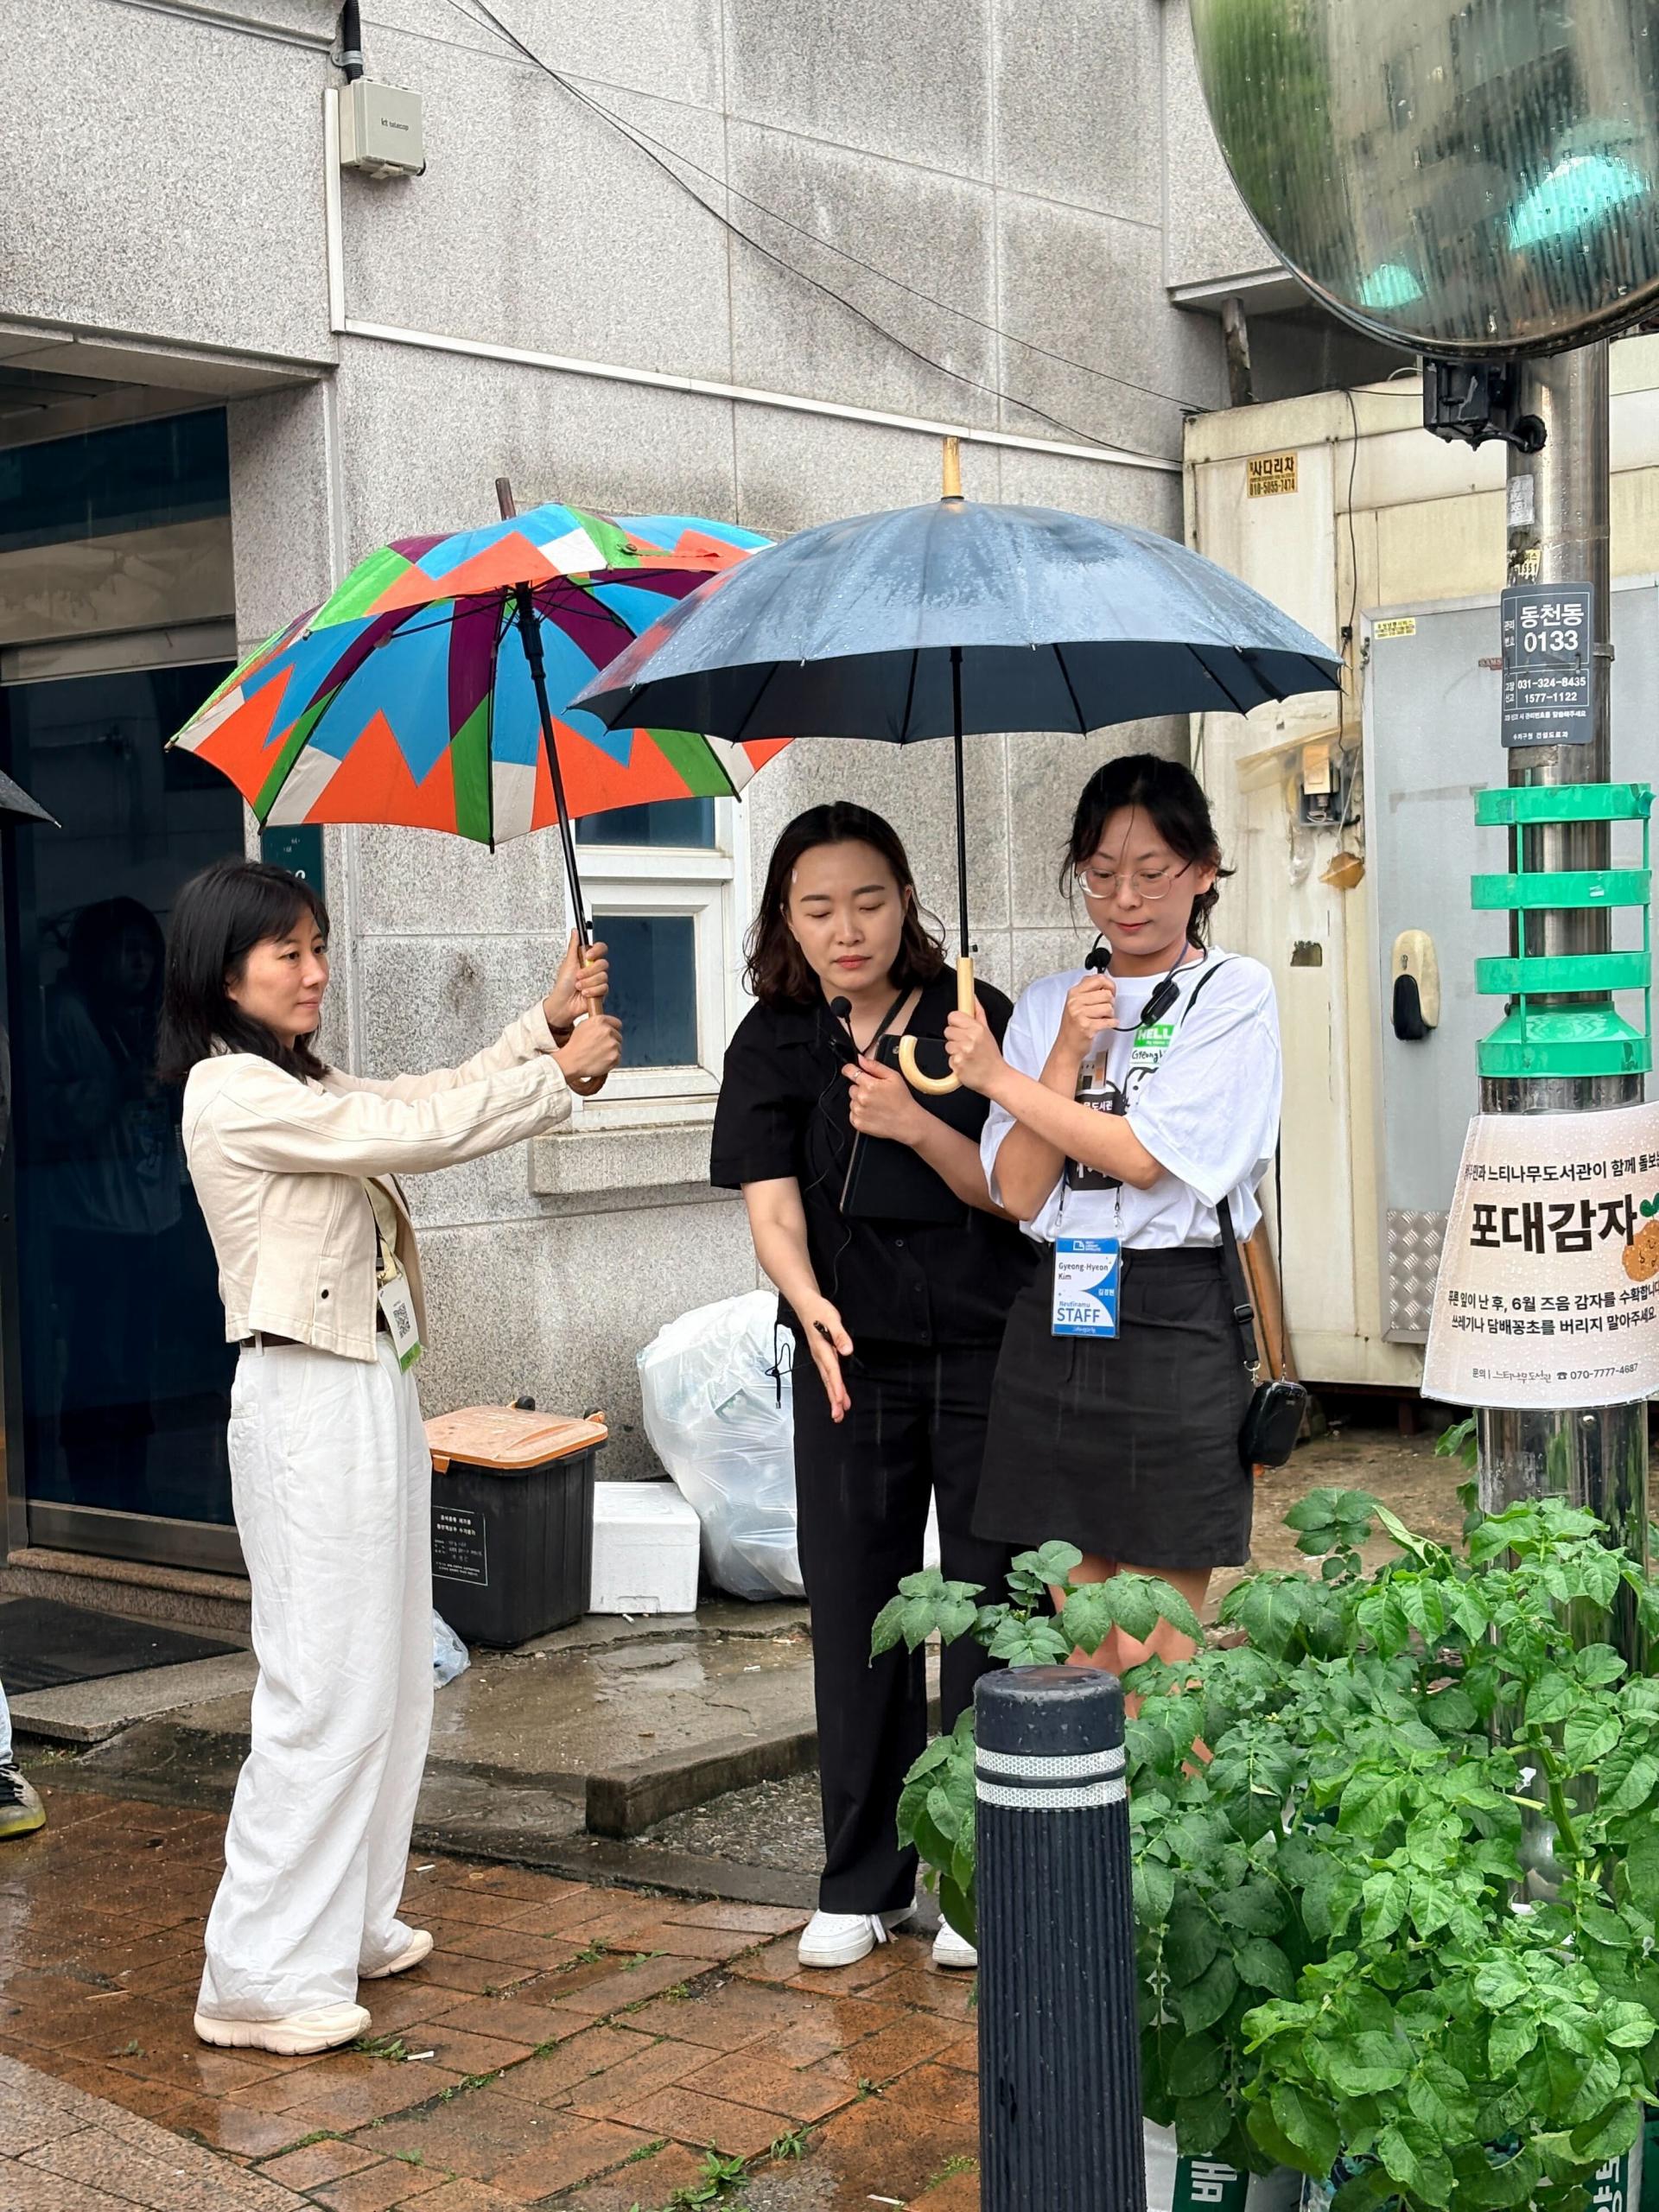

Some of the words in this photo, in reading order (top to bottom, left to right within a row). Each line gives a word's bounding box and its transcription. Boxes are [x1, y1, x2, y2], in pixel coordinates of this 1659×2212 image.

[1252, 456, 1294, 476] 사다리차
[1520, 603, 1585, 629] 동천동
[1523, 630, 1579, 653] 0133
[1517, 677, 1586, 690] 031-324-8435
[1524, 691, 1578, 704] 1577-1122
[1488, 1160, 1606, 1183] 느티나무도서관이
[1611, 1156, 1636, 1177] 함께
[1470, 1193, 1638, 1254] 포대감자
[1448, 1290, 1459, 1306] 푸른
[1460, 1292, 1476, 1309] 잎이
[1478, 1294, 1490, 1310] 난
[1491, 1295, 1508, 1313] 후,
[1511, 1296, 1536, 1313] 6월
[1541, 1296, 1570, 1311] 즈음
[1574, 1291, 1616, 1311] 감자를
[1057, 1307, 1101, 1323] STAFF
[1452, 1314, 1484, 1333] 쓰레기나
[1487, 1319, 1555, 1335] 담배꽁초를
[1560, 1316, 1603, 1335] 버리지
[1472, 1368, 1486, 1378] 문의
[1492, 1369, 1552, 1384] 느티나무도서관
[1570, 1363, 1638, 1380] 070-7777-4687
